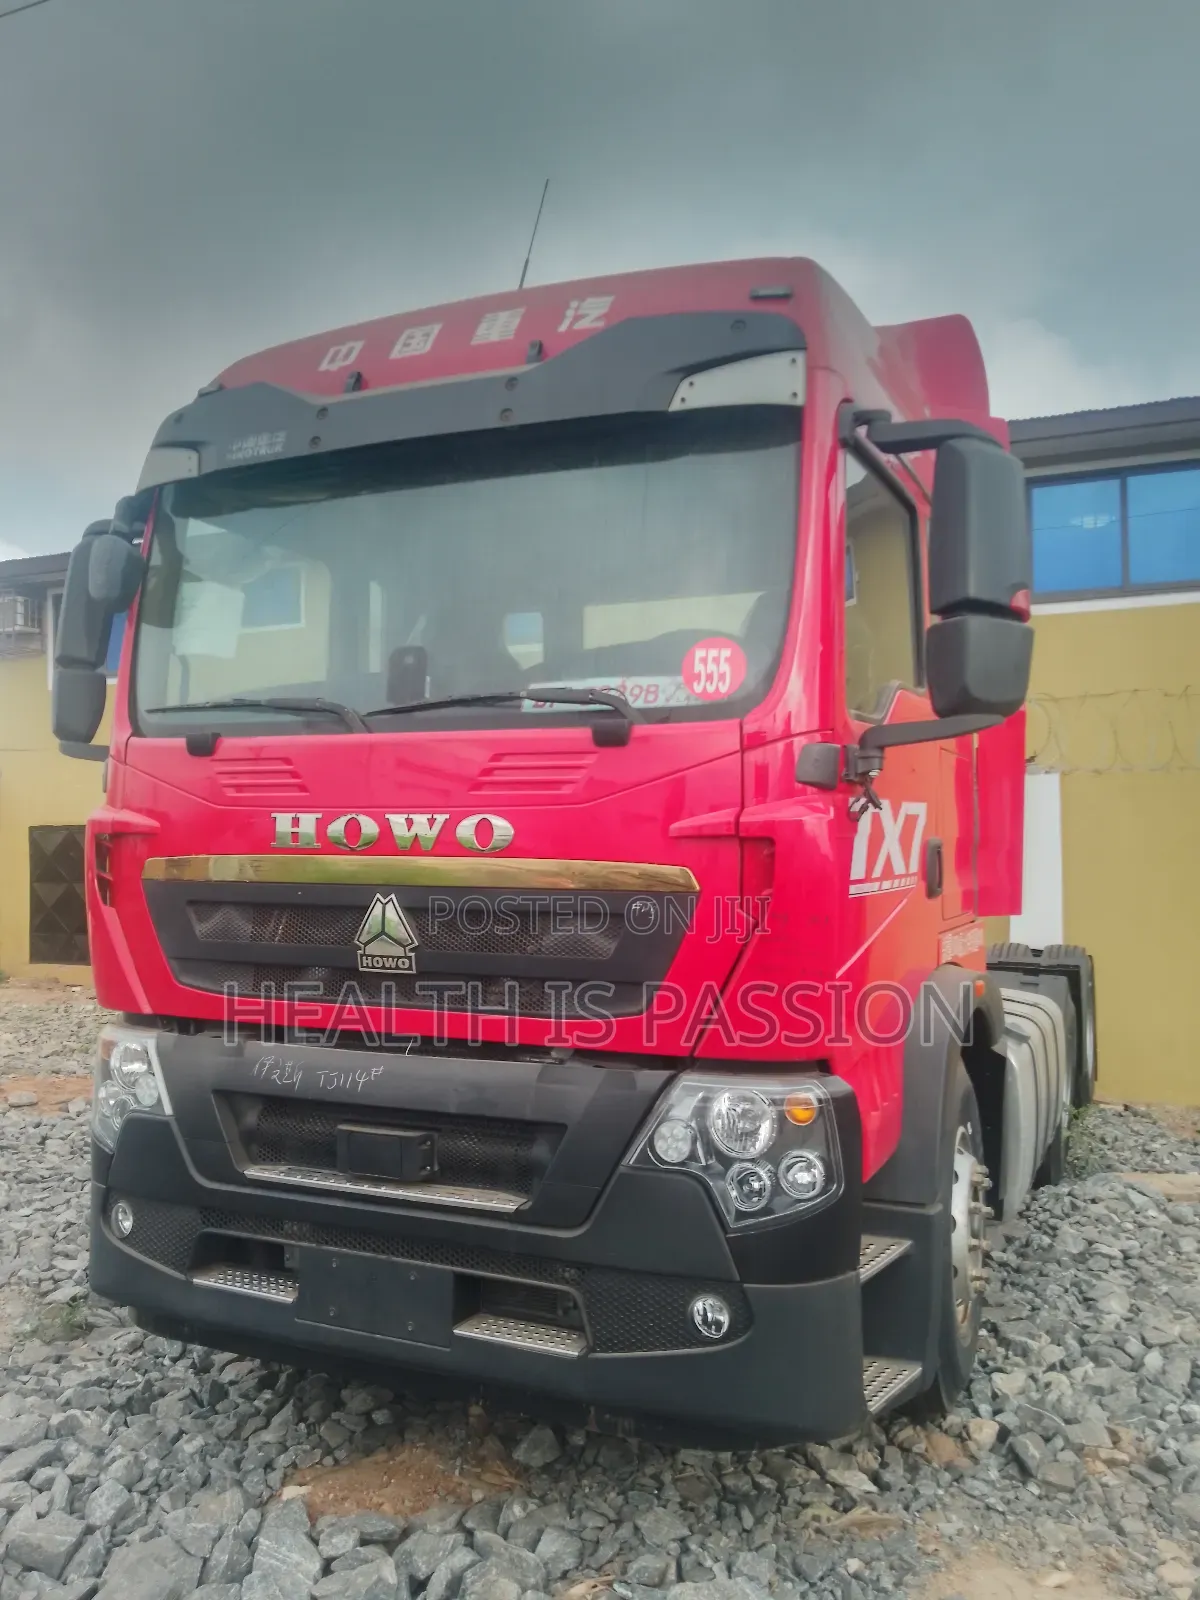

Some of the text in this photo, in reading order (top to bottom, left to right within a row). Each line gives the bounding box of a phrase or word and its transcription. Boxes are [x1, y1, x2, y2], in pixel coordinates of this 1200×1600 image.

[693, 648, 732, 693] 555
[270, 812, 515, 853] HOWO
[849, 797, 928, 880] TX7
[362, 956, 410, 969] HOWO
